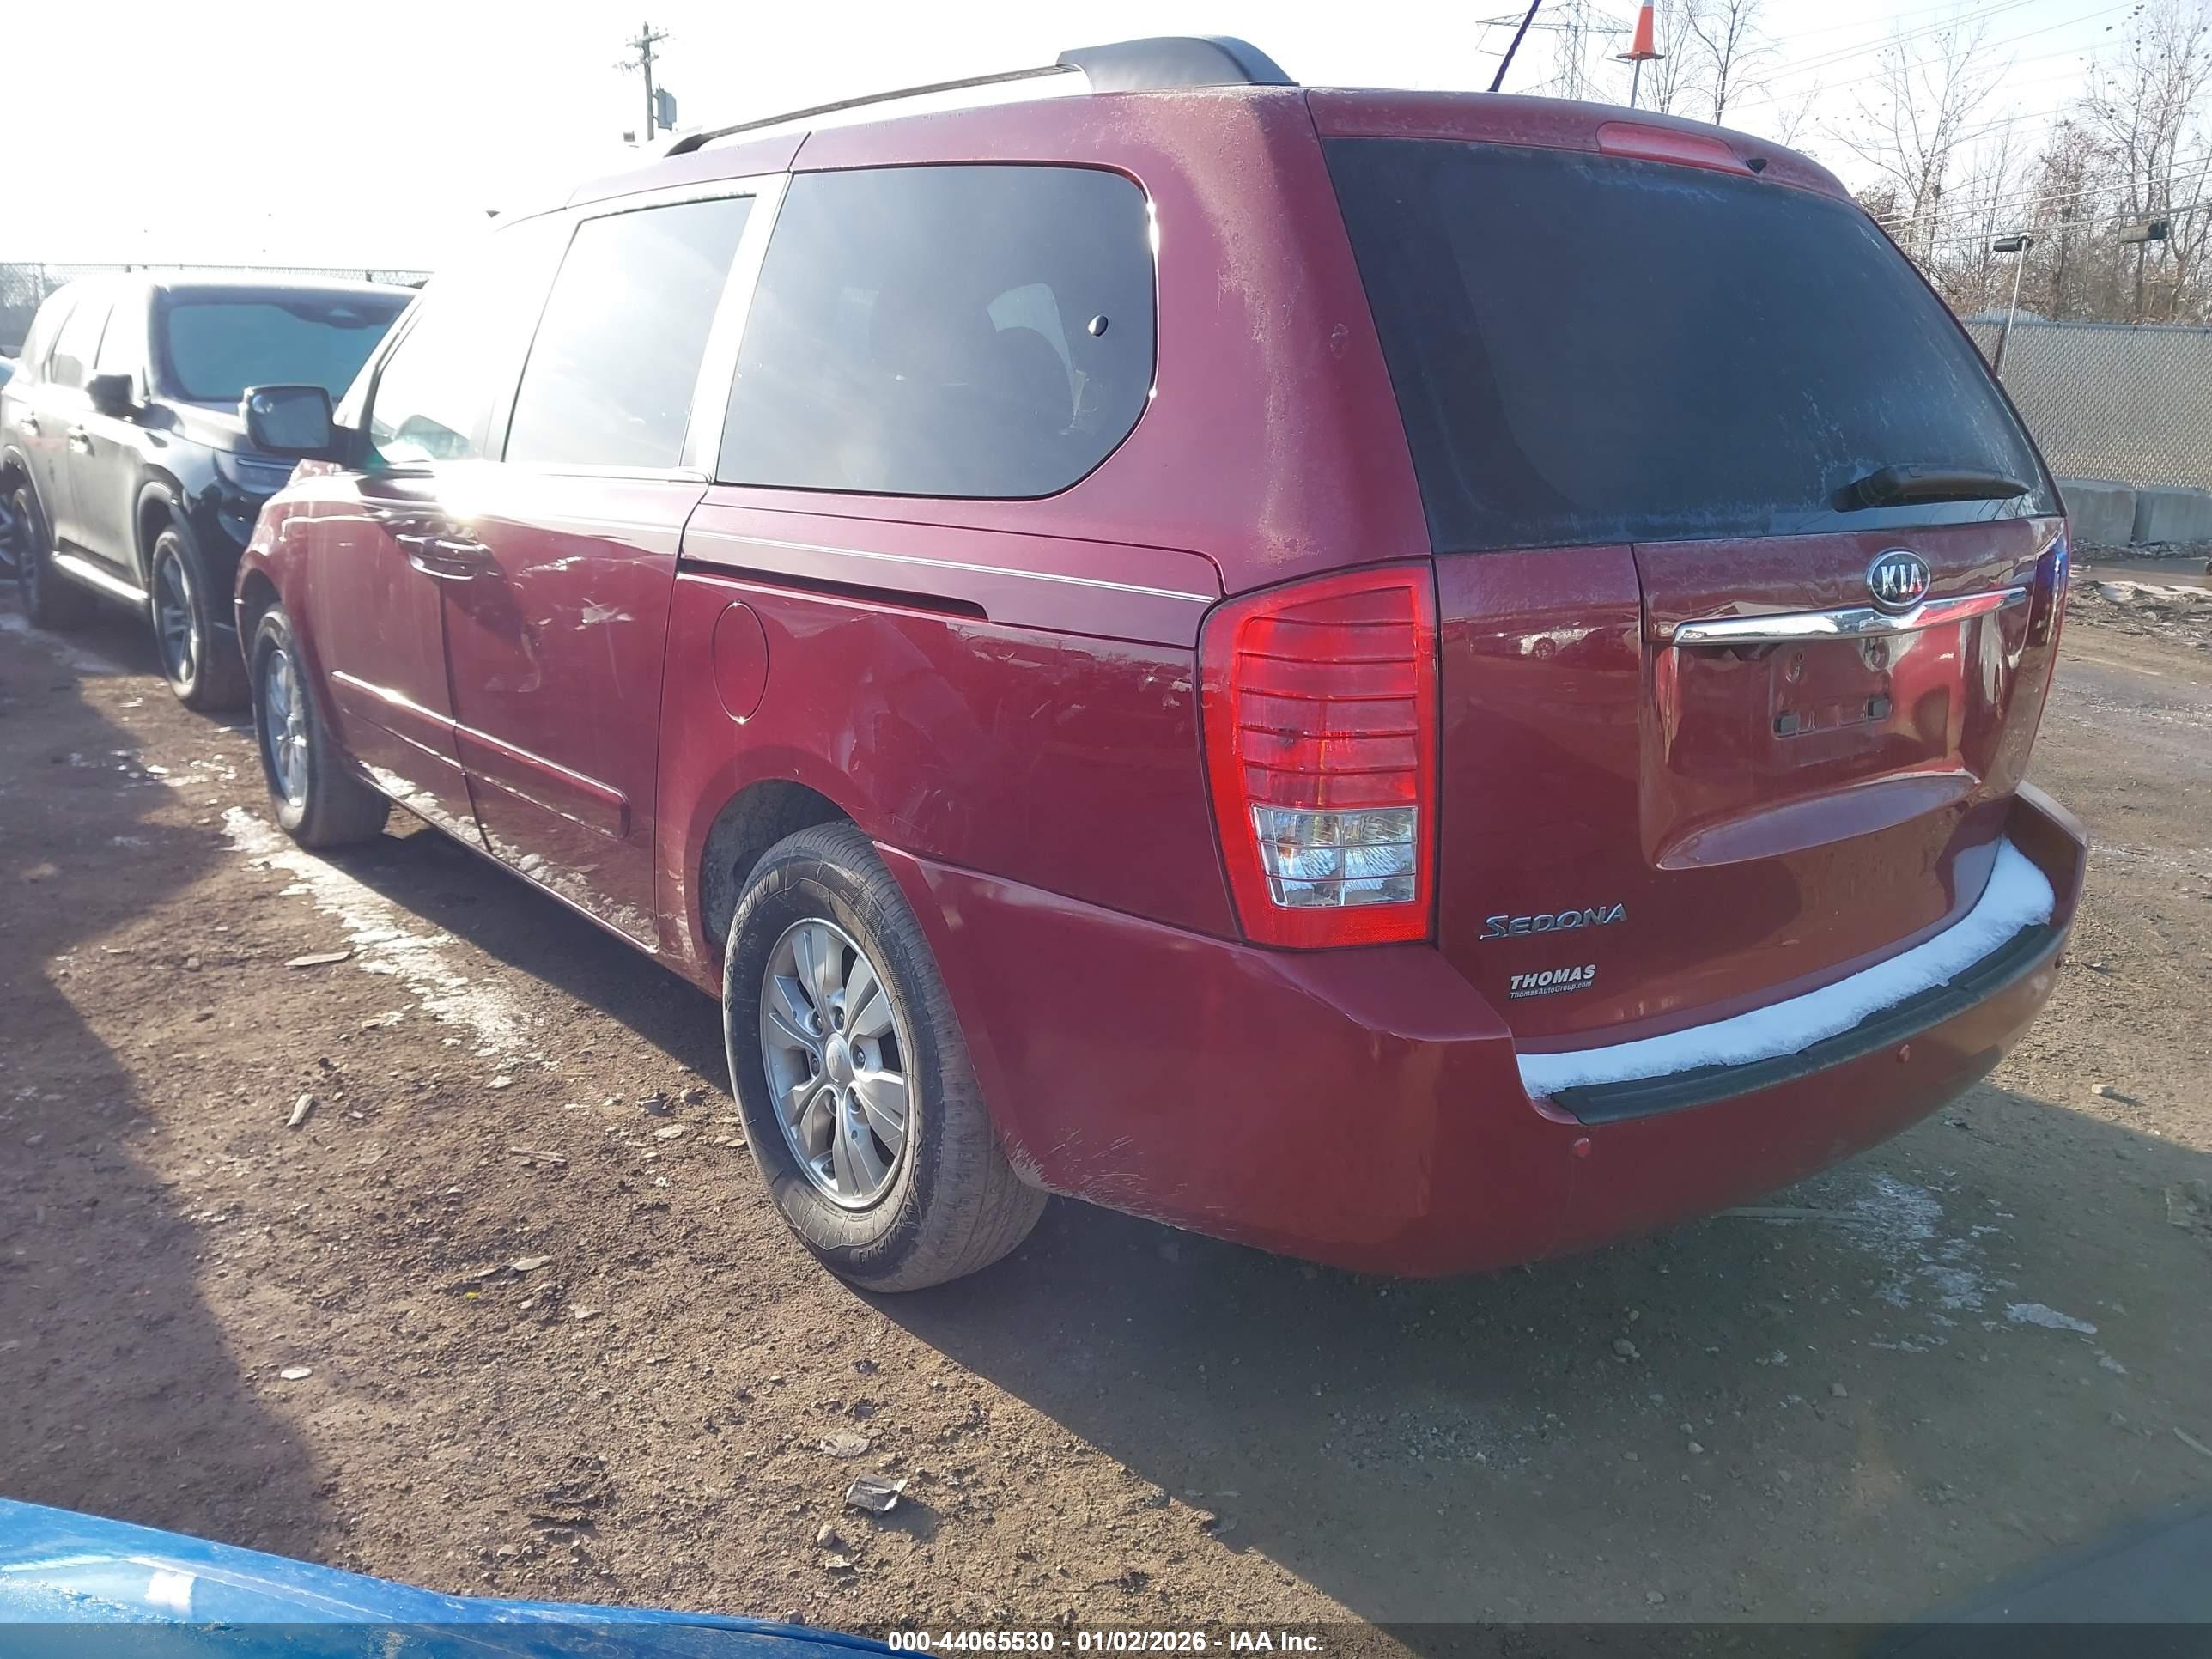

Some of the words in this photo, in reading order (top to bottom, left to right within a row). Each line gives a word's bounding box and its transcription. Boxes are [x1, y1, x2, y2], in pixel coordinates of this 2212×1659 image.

[1881, 564, 1923, 597] KIA
[1479, 902, 1627, 940] SEDONA
[1510, 964, 1596, 990] THOMAS
[1510, 981, 1593, 1000] ThomasAutoGroup.com
